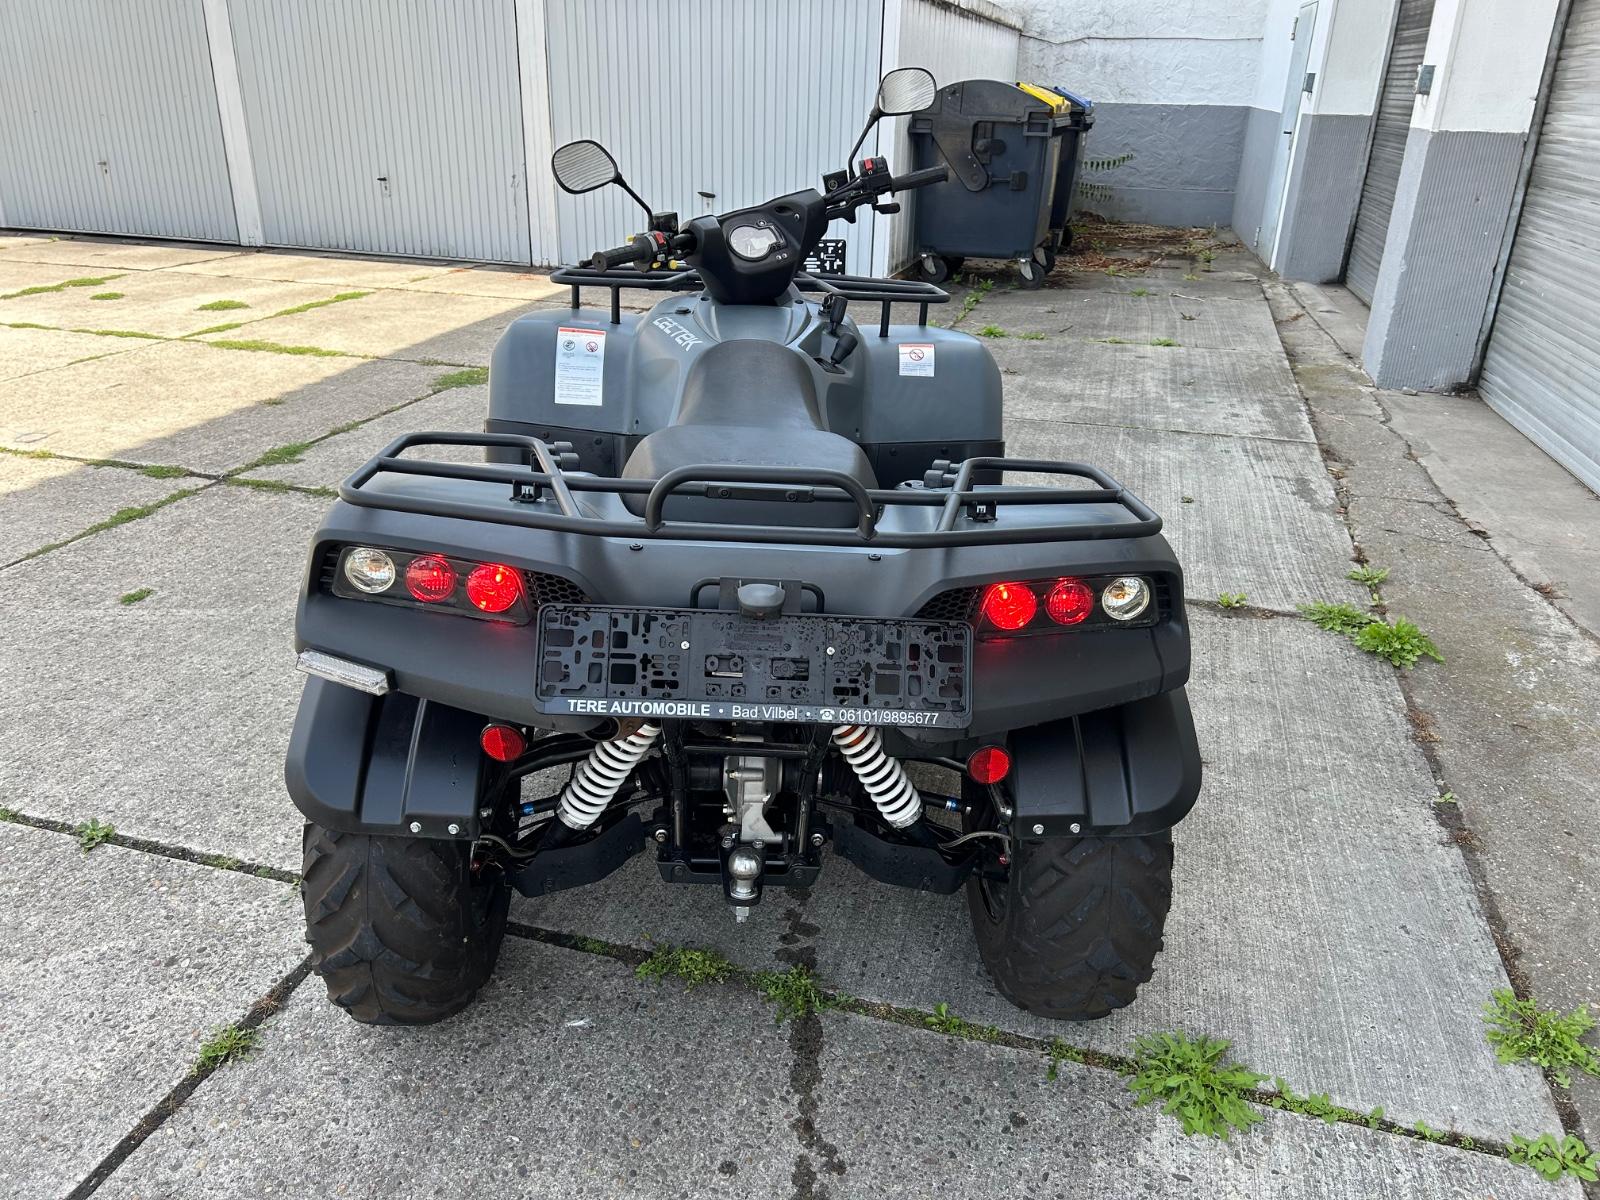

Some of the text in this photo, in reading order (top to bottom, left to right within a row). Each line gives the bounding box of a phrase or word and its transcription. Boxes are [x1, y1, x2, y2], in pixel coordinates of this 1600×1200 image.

[653, 316, 703, 351] CECTEK
[567, 699, 939, 725] TERE AUTOMOBILE Bad Vilbel 06101/9895677
